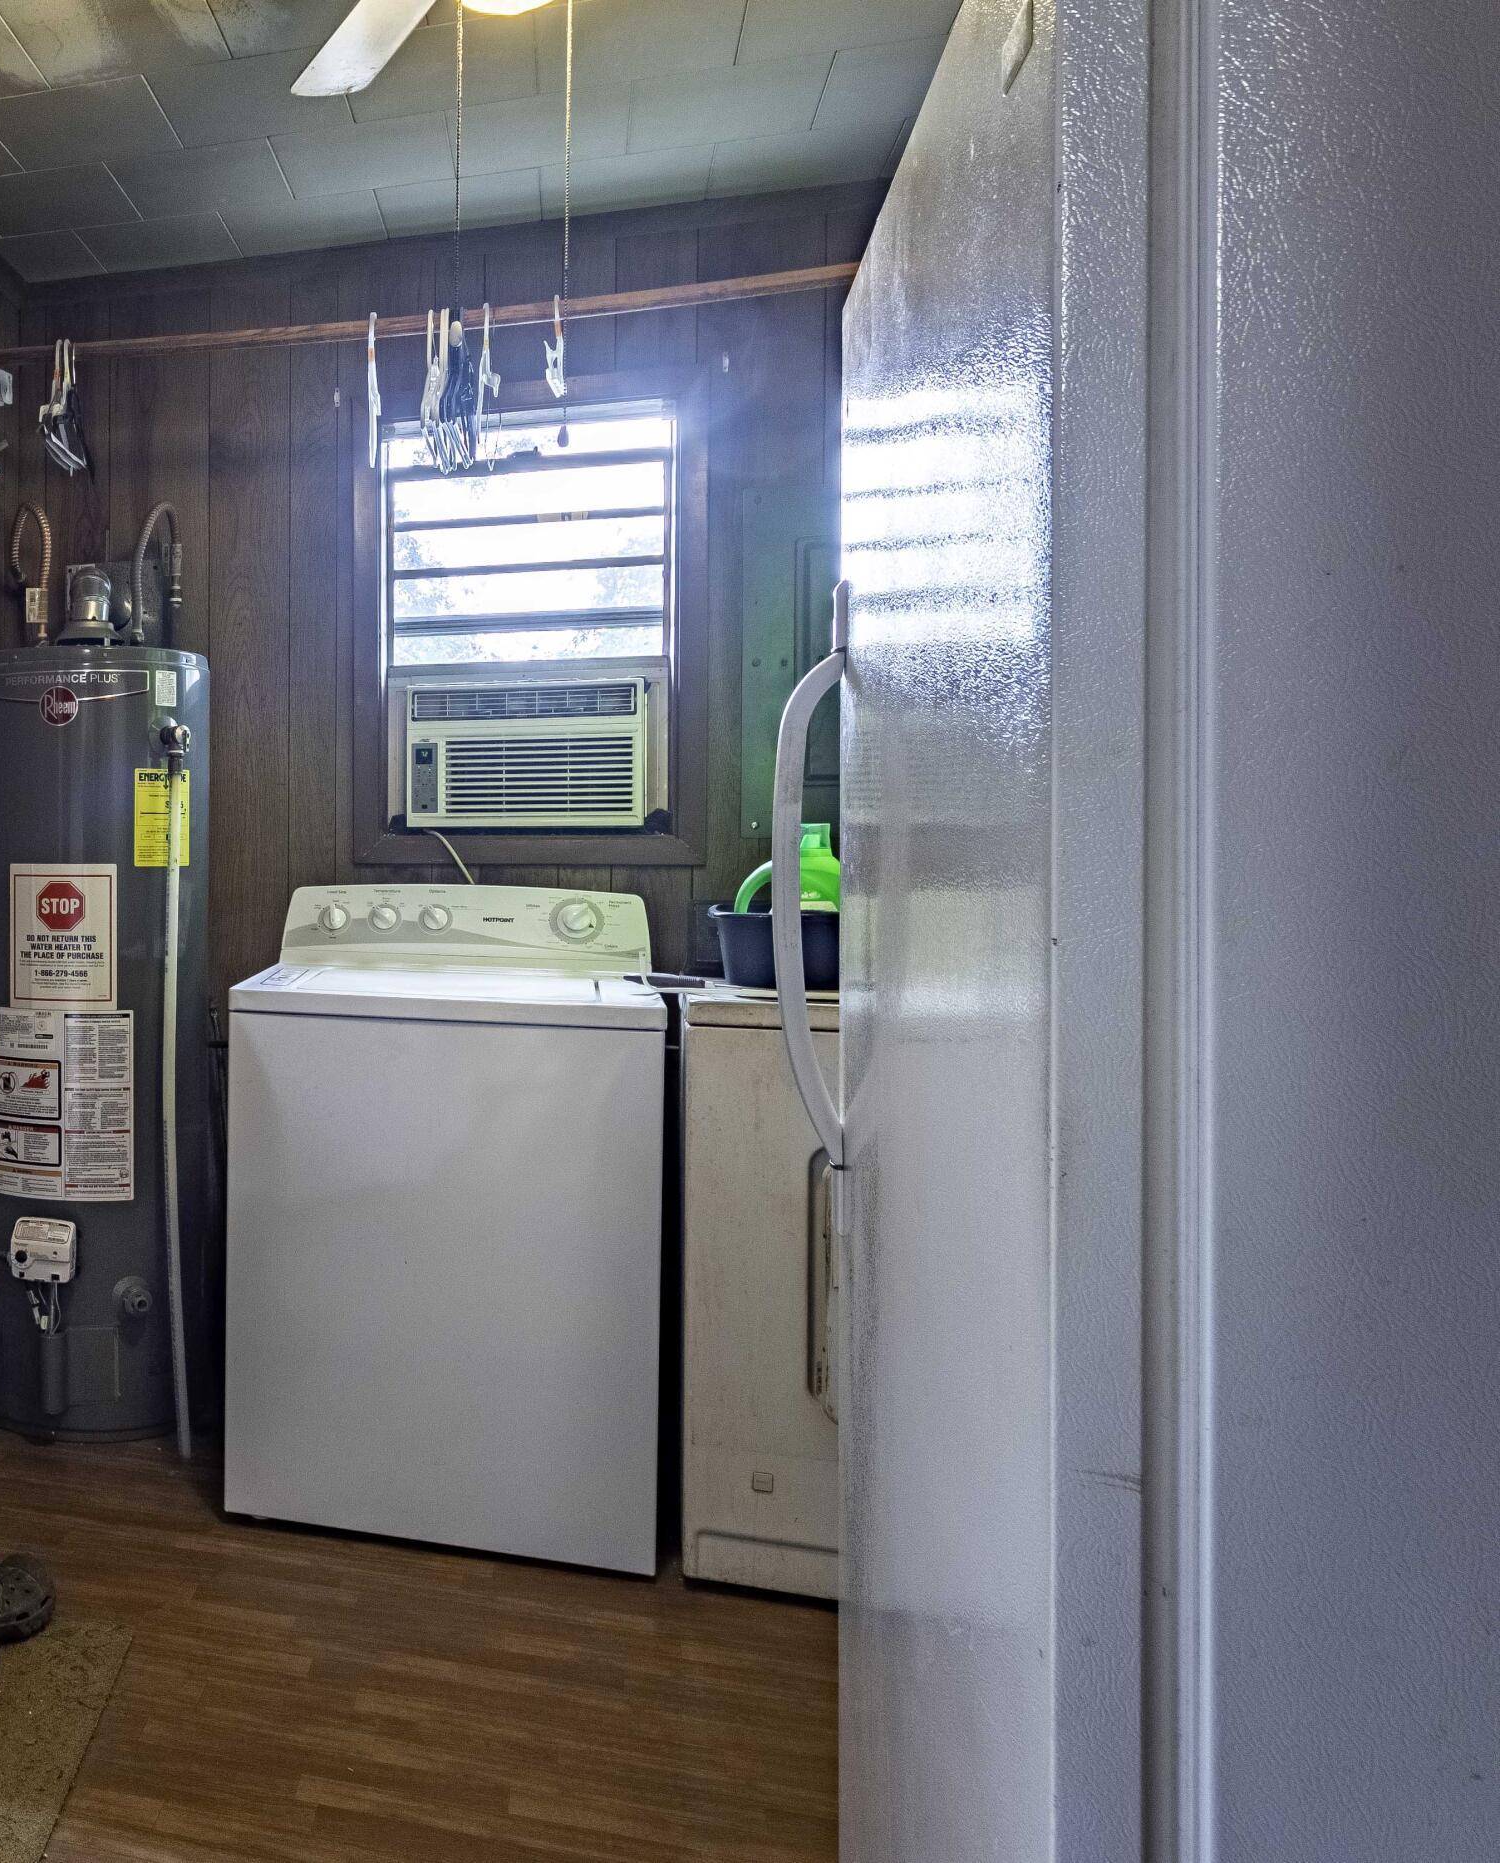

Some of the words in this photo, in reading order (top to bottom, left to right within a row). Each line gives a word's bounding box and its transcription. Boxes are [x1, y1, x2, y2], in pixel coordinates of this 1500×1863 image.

[5, 674, 87, 686] PERFORMANCE
[90, 673, 119, 683] PLUS
[44, 688, 76, 719] Rheem
[41, 898, 80, 915] STOP
[26, 934, 35, 942] DO
[37, 934, 49, 942] NOT
[81, 935, 97, 943] THIS
[20, 951, 32, 959] THE
[67, 952, 104, 960] PURCHASE
[34, 969, 88, 977] 1-866-279-4566
